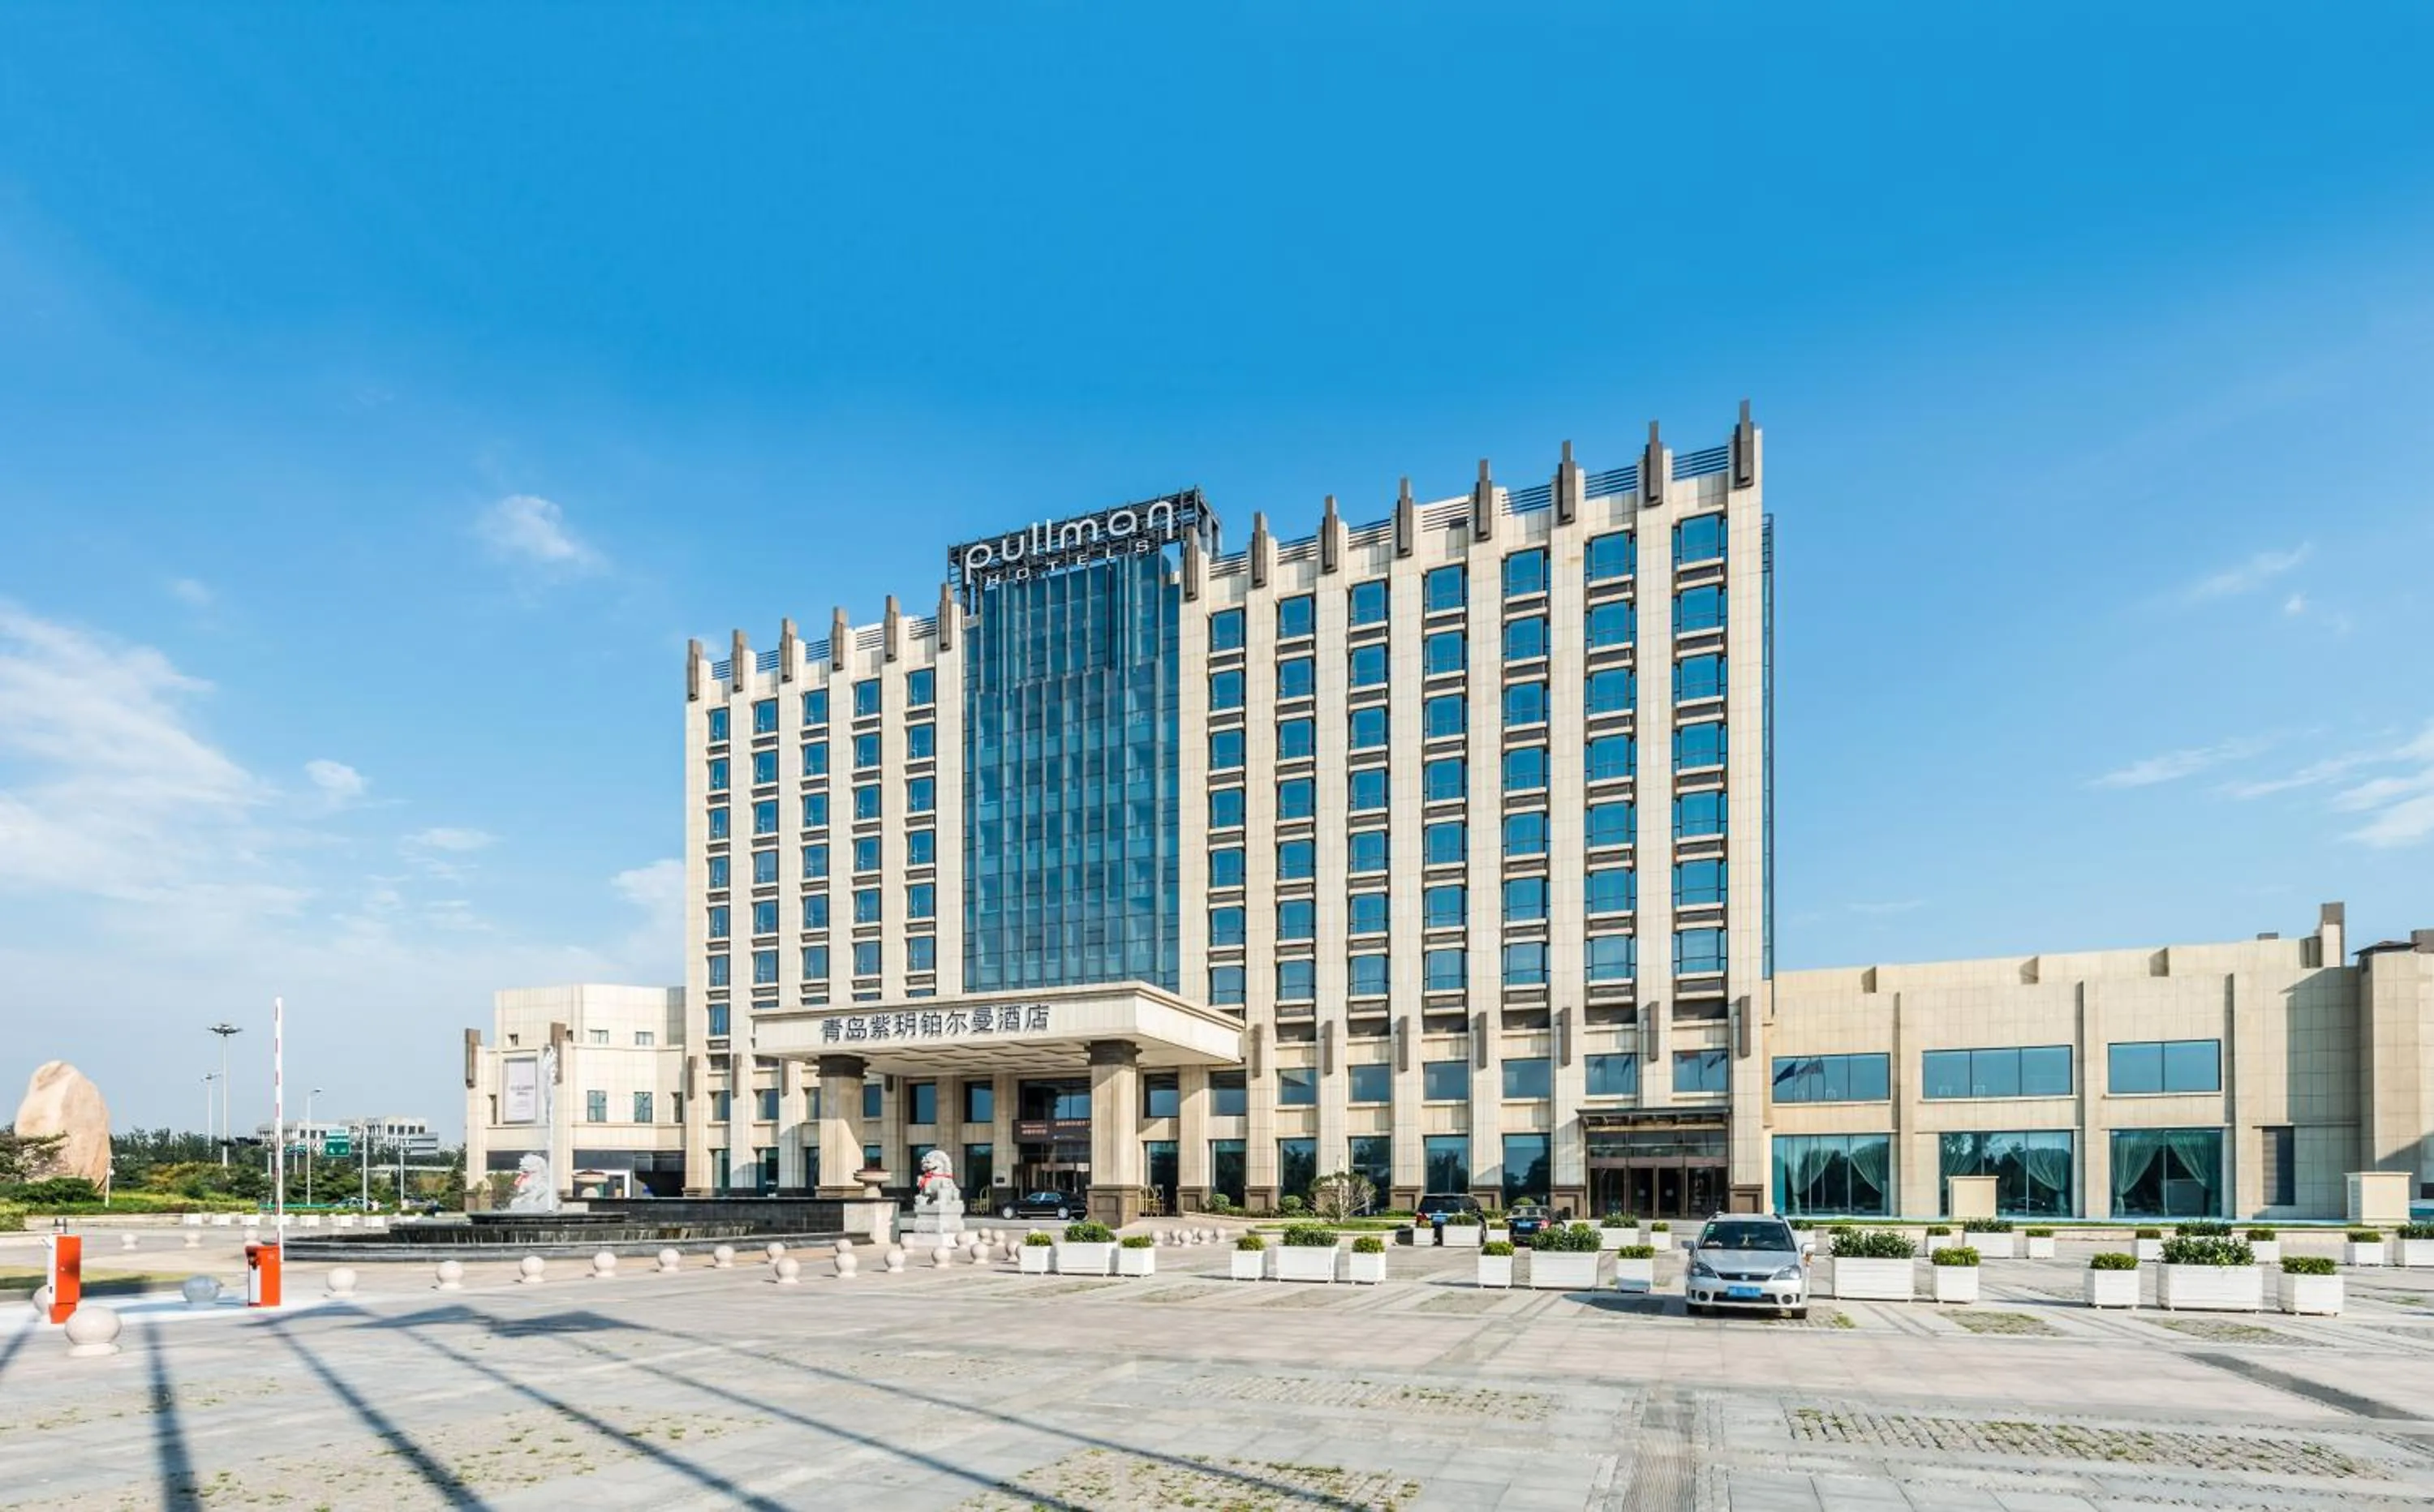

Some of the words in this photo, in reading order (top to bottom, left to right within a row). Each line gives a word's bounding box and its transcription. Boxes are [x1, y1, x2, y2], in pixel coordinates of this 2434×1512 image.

[965, 500, 1173, 584] pullman
[987, 539, 1149, 585] HOTELS
[821, 1004, 1049, 1043] 青岛紫玥铂尔曼酒店
